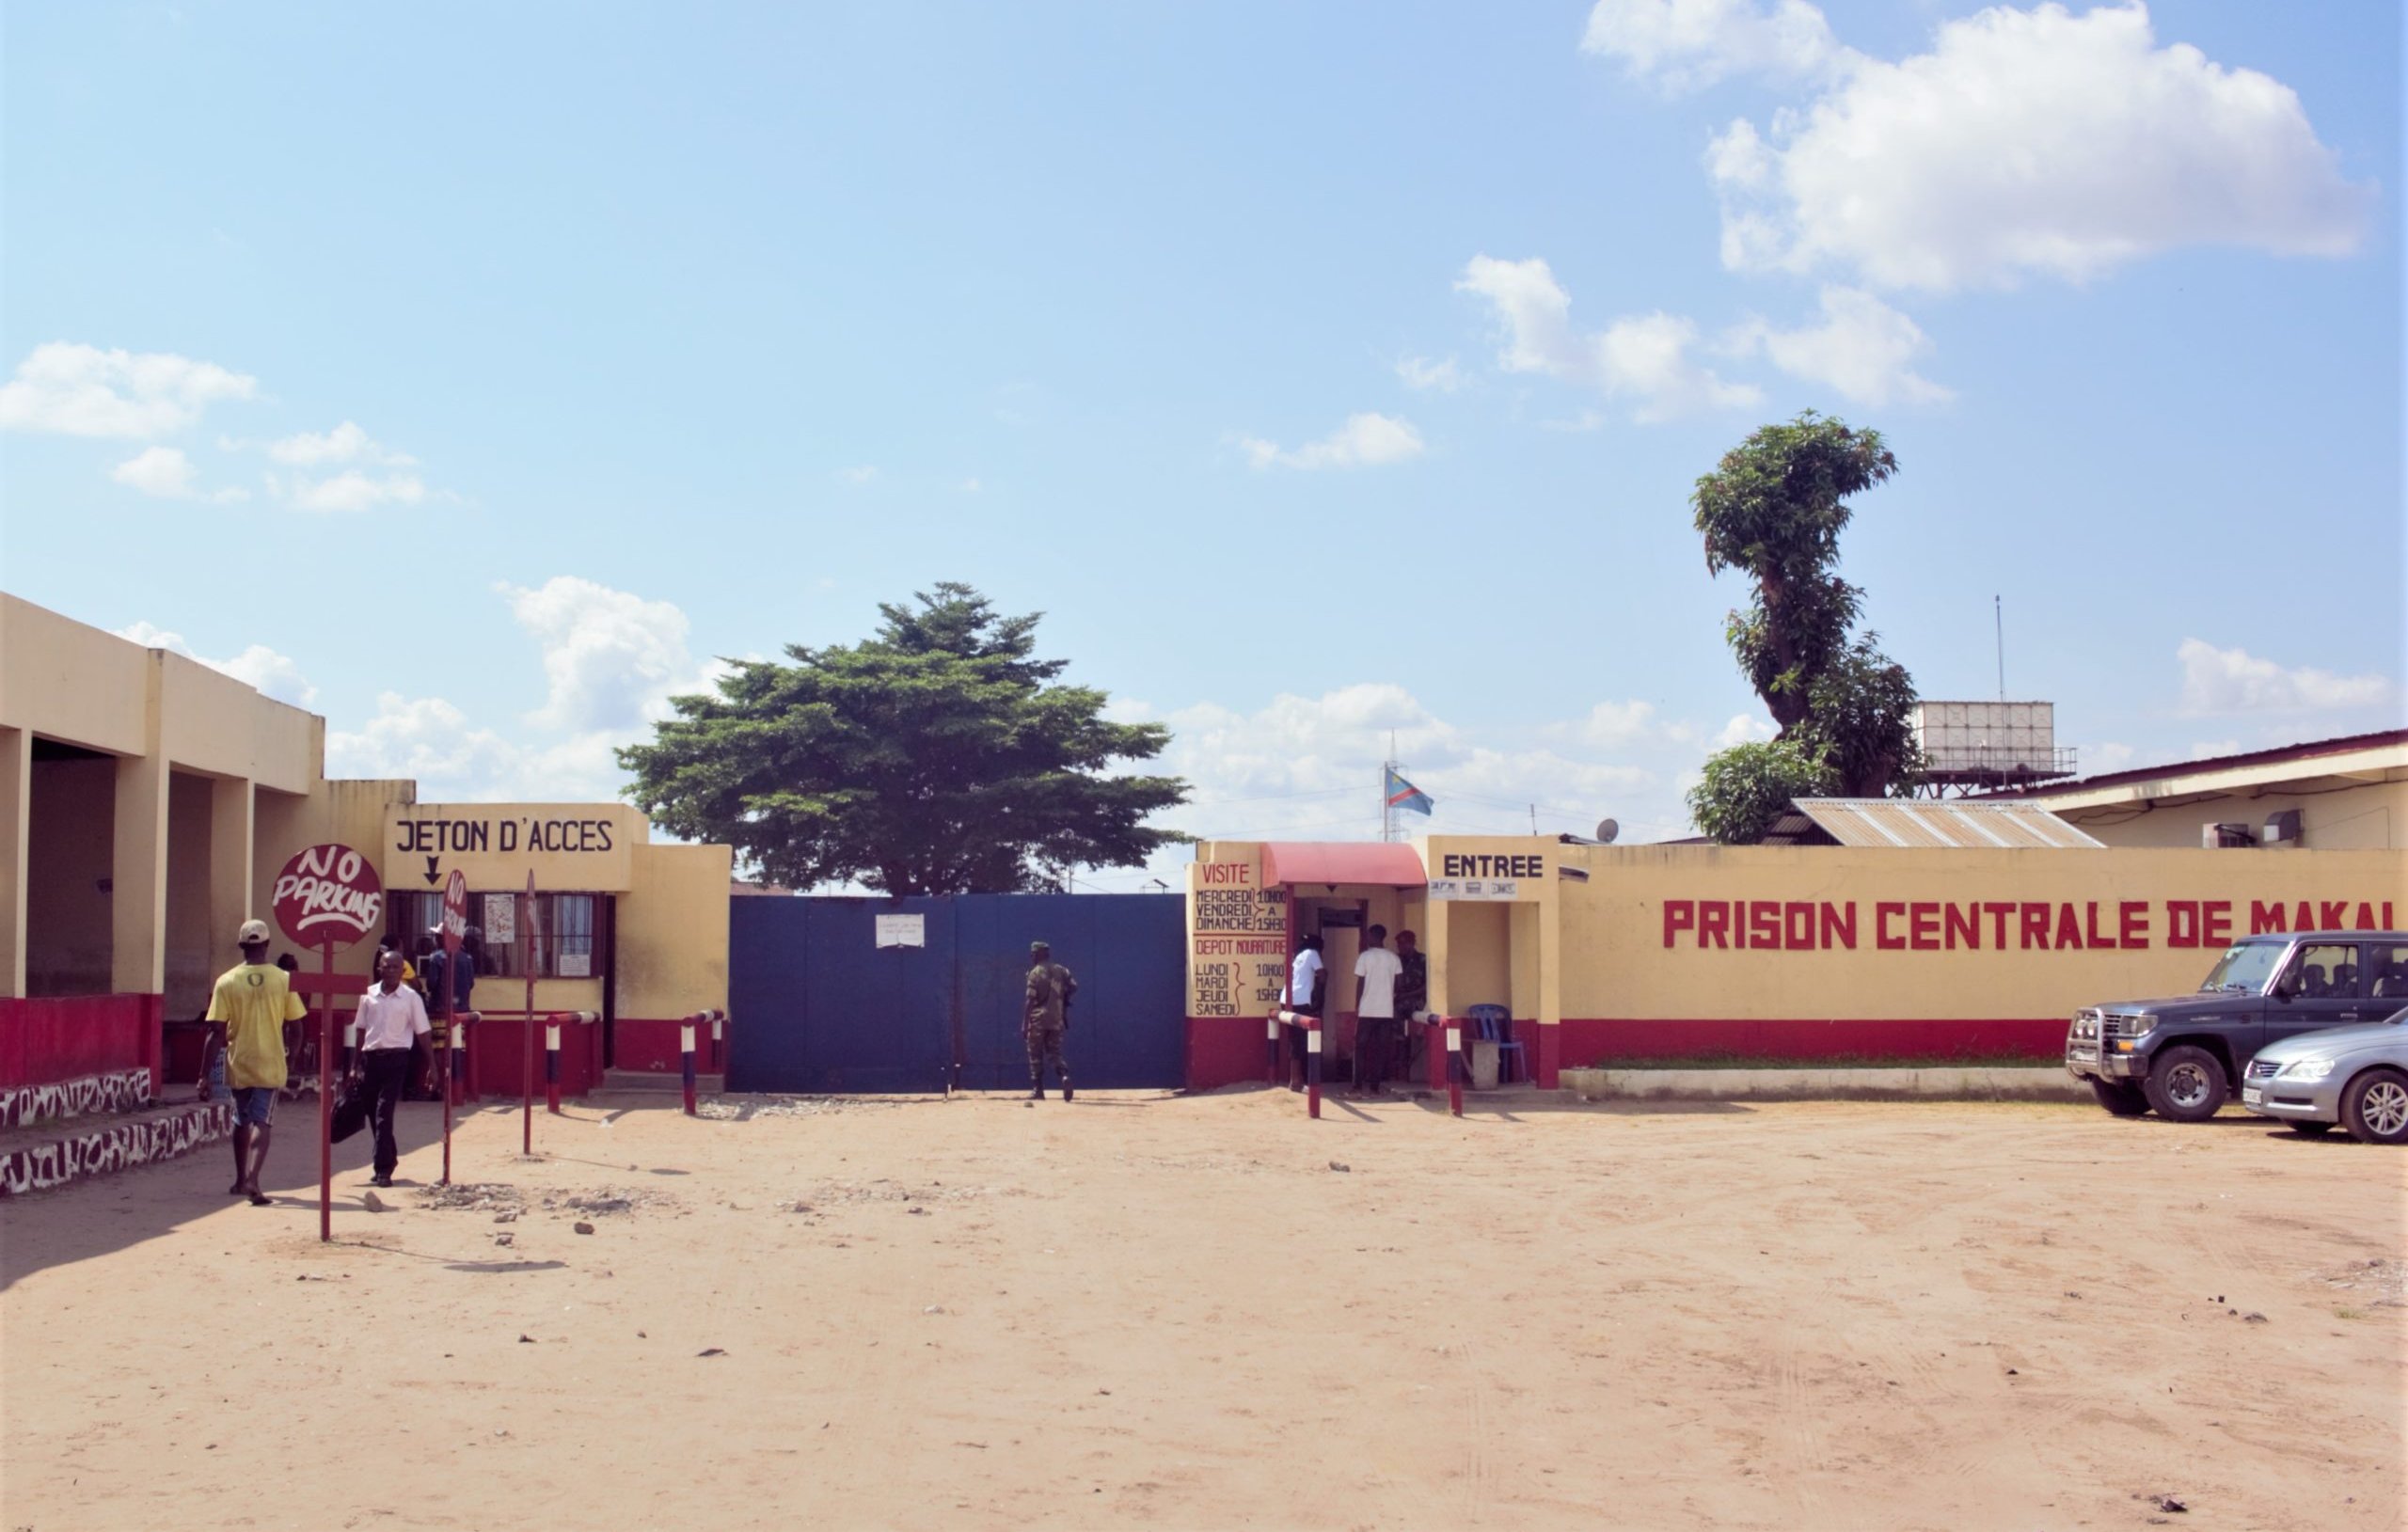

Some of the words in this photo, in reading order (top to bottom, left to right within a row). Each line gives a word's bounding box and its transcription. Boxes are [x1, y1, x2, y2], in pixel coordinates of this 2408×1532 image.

[397, 820, 489, 852] JETON
[499, 817, 613, 852] D'ACCES
[296, 845, 362, 883] NO
[1444, 855, 1544, 878] ENTREE
[1202, 863, 1250, 884] VISITE
[272, 875, 382, 929] PARKING
[1196, 890, 1253, 903] MERCREDI
[1256, 890, 1287, 904] 10H00
[1196, 904, 1253, 917] VENDREDI
[1267, 906, 1276, 917] A
[1196, 917, 1253, 930] DIMANCHE
[1256, 917, 1287, 931] 15H30
[1663, 900, 1857, 950] PRISON
[1877, 901, 2149, 950] CENTRALE
[2166, 900, 2232, 948] DE
[1196, 940, 1233, 956] DEPOT
[1236, 940, 1287, 956] NOURRITURE
[1196, 963, 1228, 976] LUNDI
[1256, 963, 1285, 977] 10H00
[1196, 977, 1228, 989] MARDI
[1267, 978, 1274, 987] A
[1196, 990, 1228, 1003] JEUDI
[1256, 988, 1283, 1002] 15H3
[1196, 1003, 1235, 1016] SAMEDI
